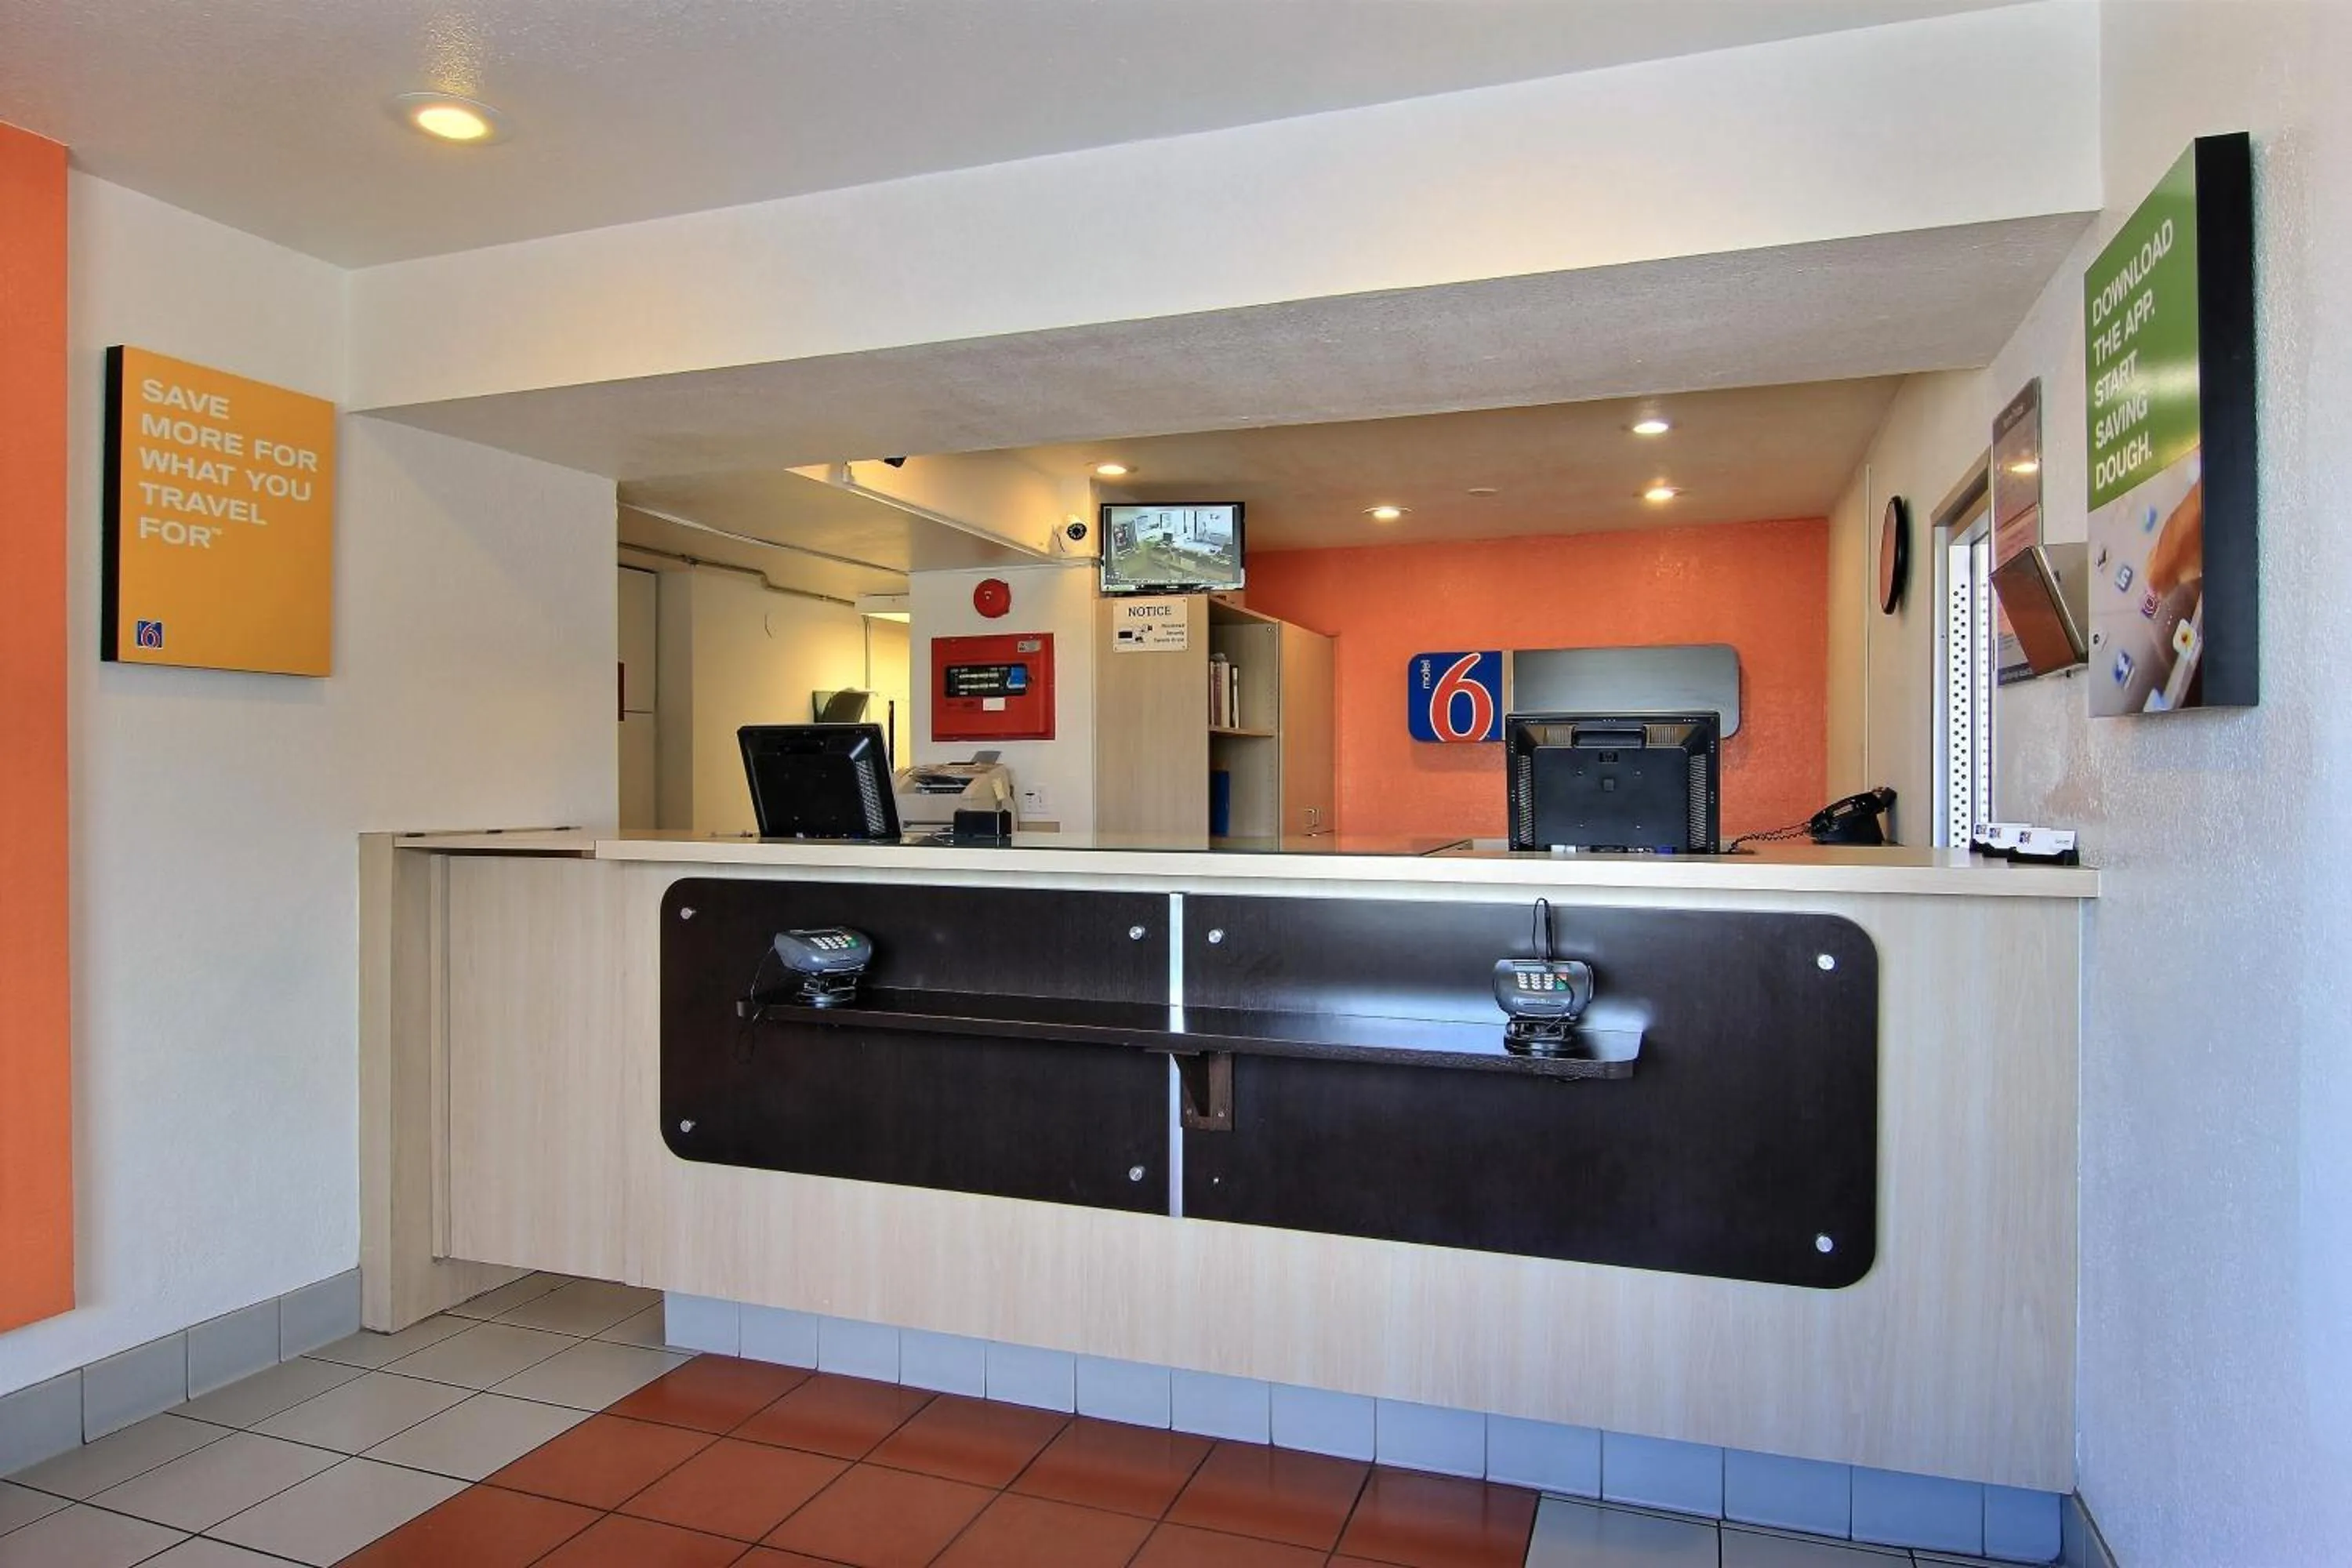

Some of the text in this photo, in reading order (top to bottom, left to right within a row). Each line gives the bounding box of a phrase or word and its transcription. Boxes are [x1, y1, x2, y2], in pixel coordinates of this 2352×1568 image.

[2092, 219, 2173, 327] DOWNLOAD
[2093, 289, 2155, 366] THE APP.
[142, 379, 230, 420] SAVE
[2094, 349, 2137, 408] START
[142, 413, 318, 473] MORE FOR
[2096, 391, 2147, 450] SAVING
[140, 447, 312, 502] WHAT YOU
[2096, 430, 2152, 491] DOUGH.
[140, 481, 267, 525] TRAVEL
[1128, 606, 1172, 617] NOTICE
[1420, 659, 1431, 689] motel
[1429, 652, 1494, 742] 6
